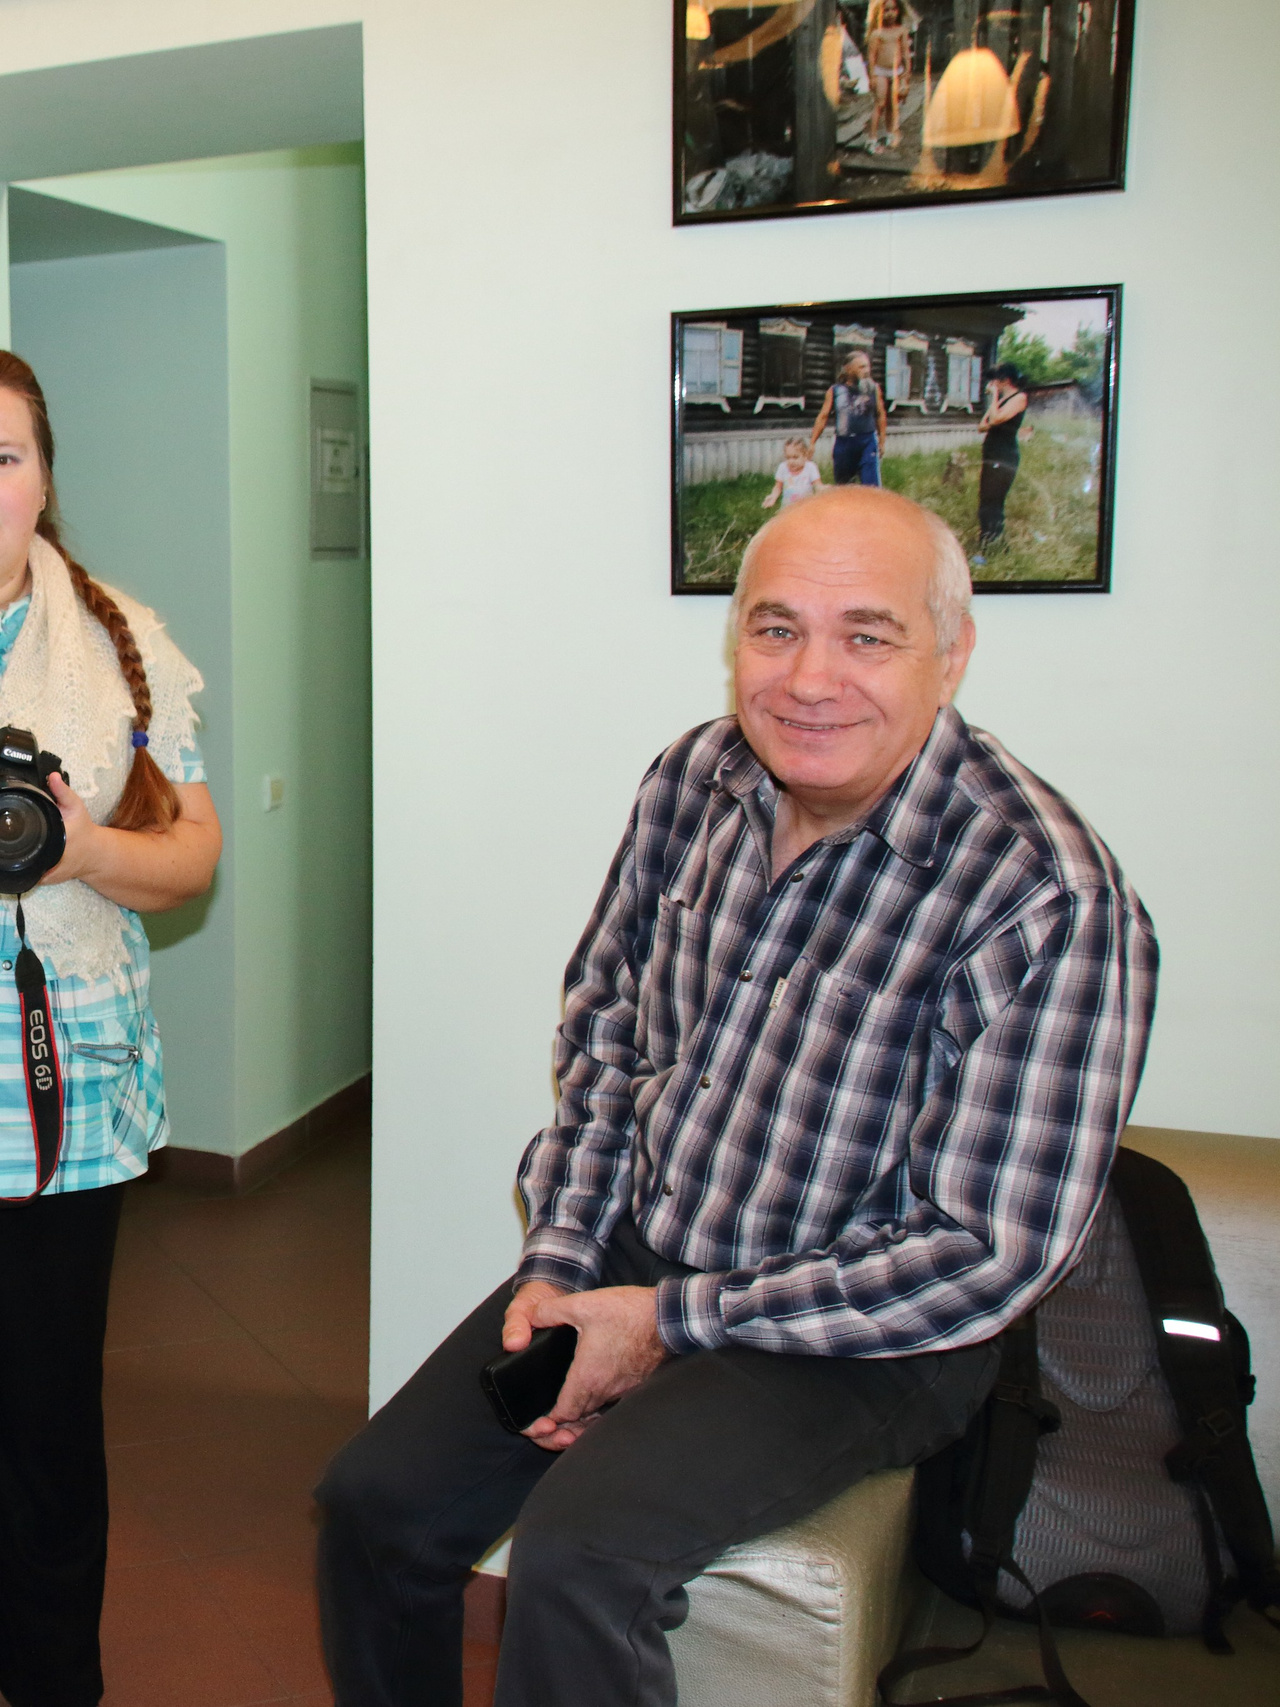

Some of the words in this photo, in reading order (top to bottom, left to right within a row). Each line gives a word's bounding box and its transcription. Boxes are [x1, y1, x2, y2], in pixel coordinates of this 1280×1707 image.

[3, 748, 33, 762] Canon
[29, 1009, 48, 1060] EOS
[34, 1066, 53, 1091] 6D
